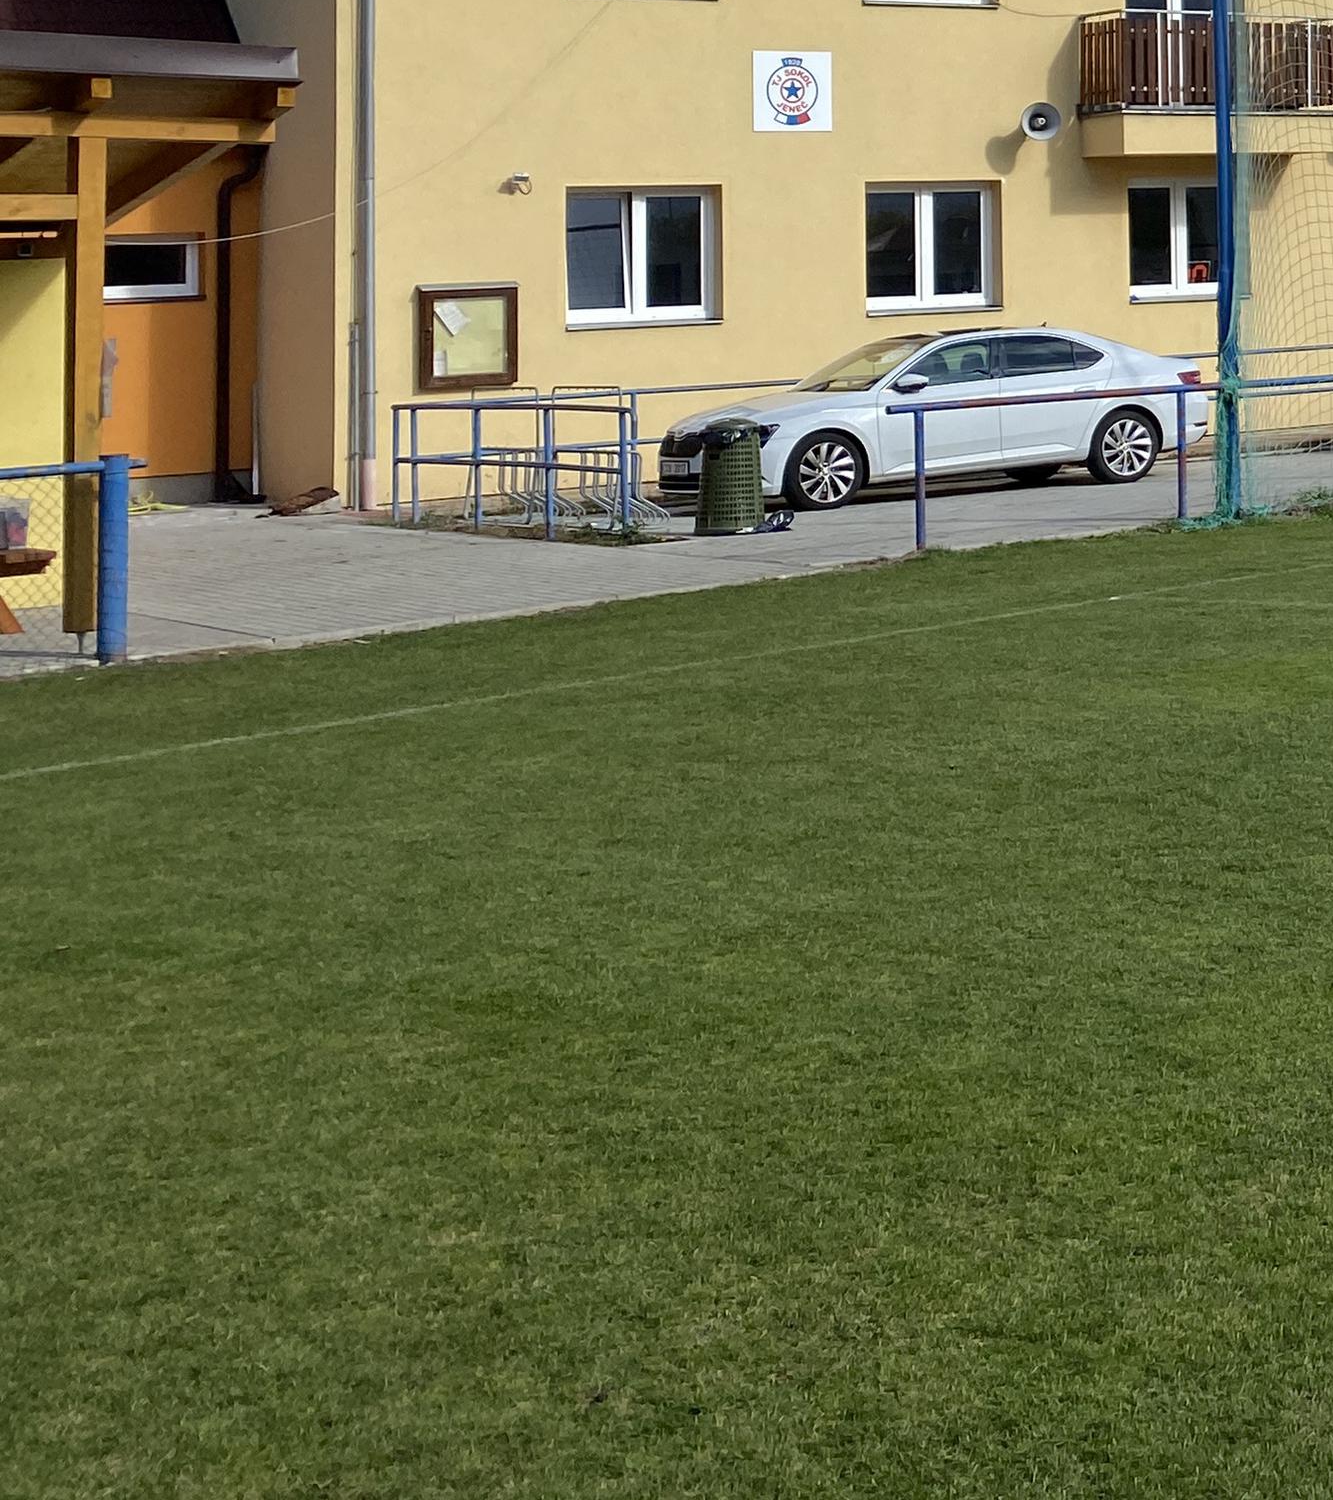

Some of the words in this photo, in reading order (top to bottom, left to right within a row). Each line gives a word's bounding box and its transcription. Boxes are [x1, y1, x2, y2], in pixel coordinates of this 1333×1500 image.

[771, 75, 782, 86] TJ
[784, 68, 813, 87] SOKOL
[776, 101, 808, 113] JENEČ
